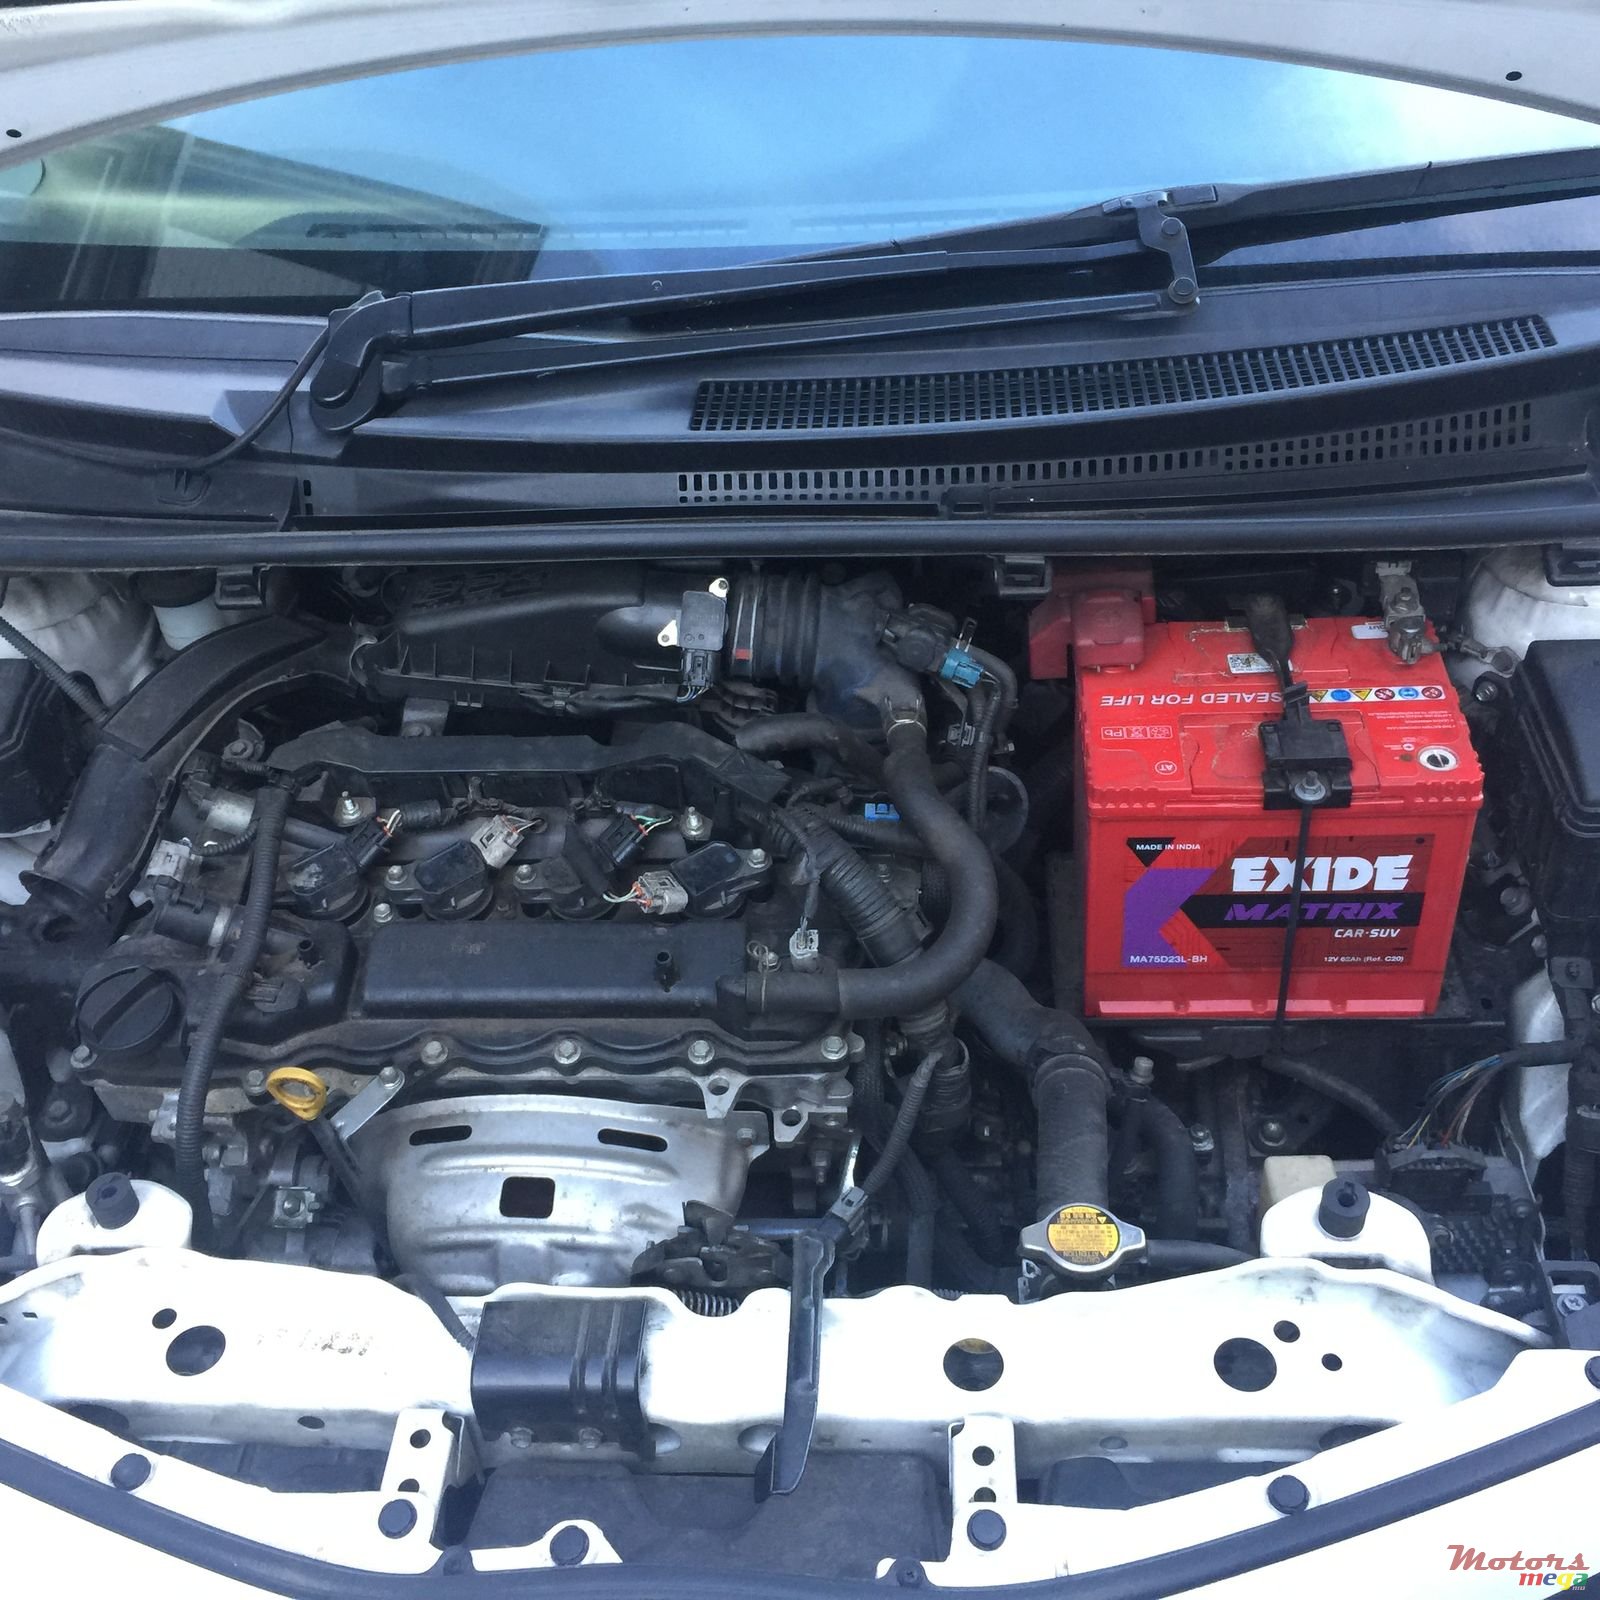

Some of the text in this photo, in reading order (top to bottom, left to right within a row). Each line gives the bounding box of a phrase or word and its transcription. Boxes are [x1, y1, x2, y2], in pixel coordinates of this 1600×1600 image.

[1100, 692, 1282, 707] SEALED FOR LIFE
[1104, 729, 1123, 737] Pb
[1136, 843, 1163, 851] MADE
[1164, 843, 1175, 851] IN
[1231, 855, 1414, 892] EXIDE
[1224, 902, 1404, 921] MATRIX
[1129, 955, 1208, 963] MA75D23L-BH
